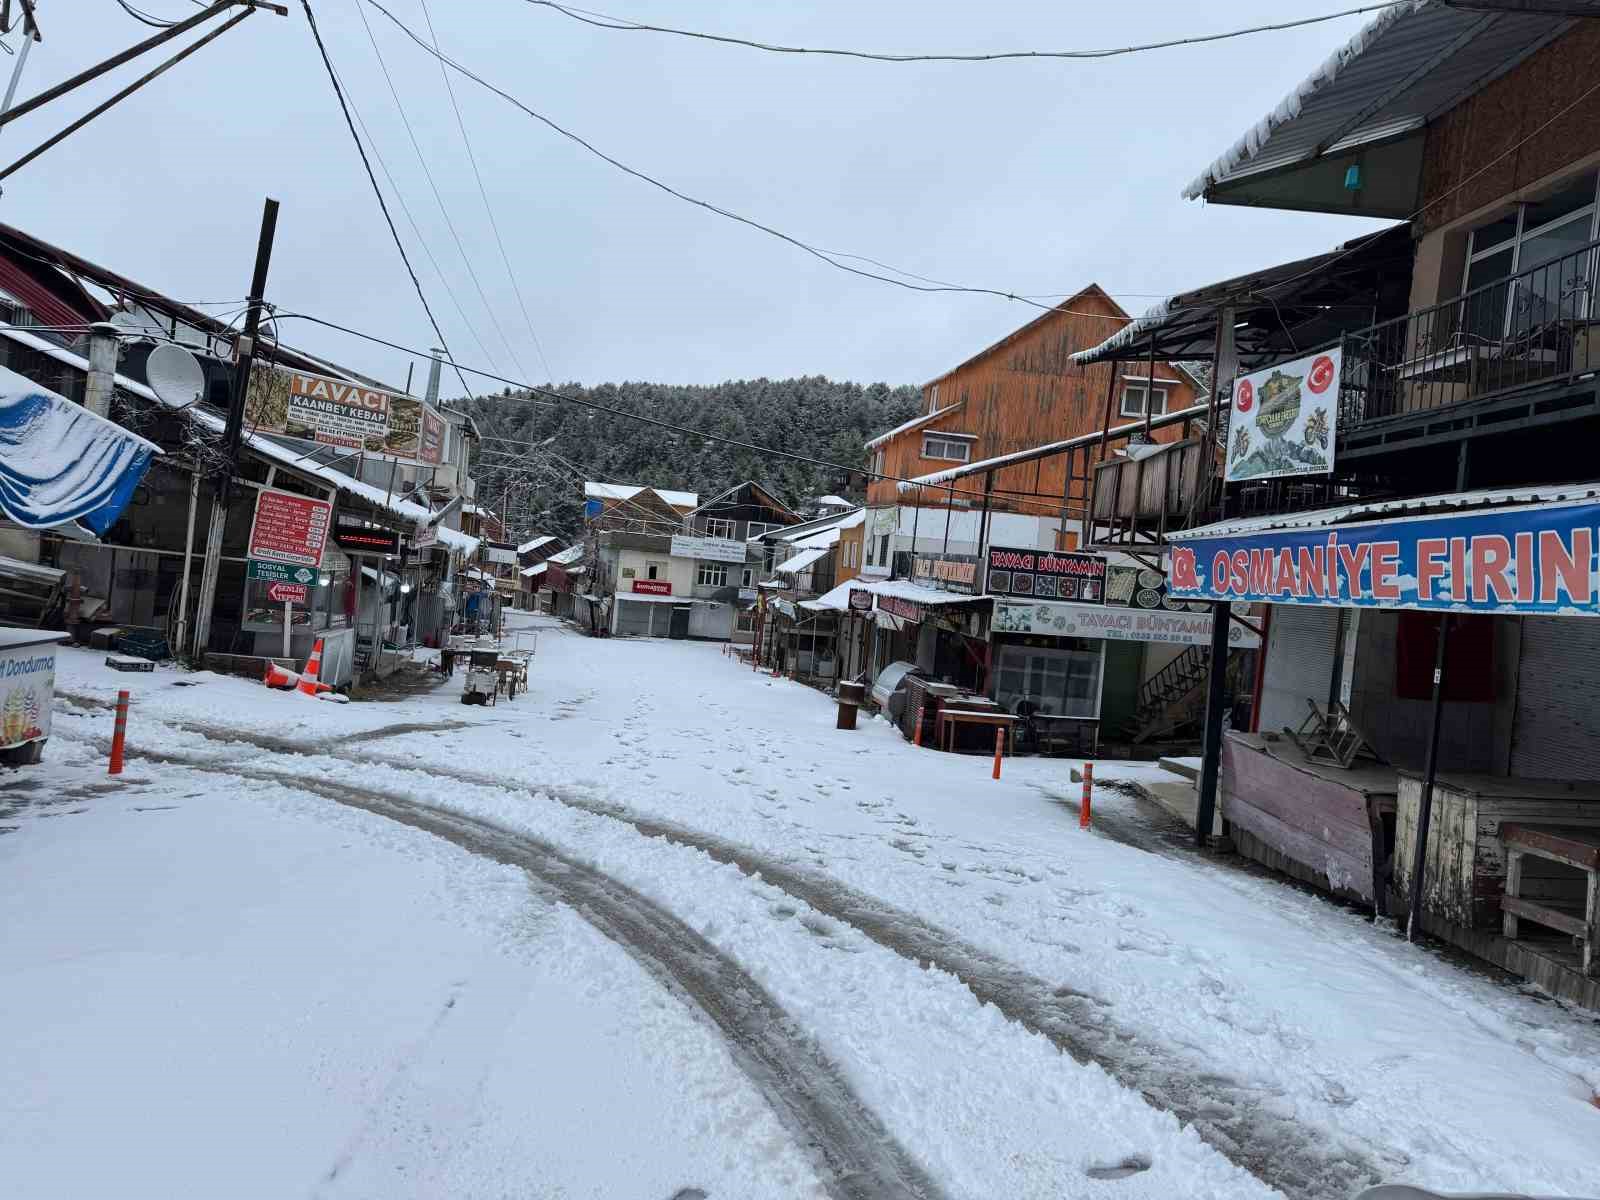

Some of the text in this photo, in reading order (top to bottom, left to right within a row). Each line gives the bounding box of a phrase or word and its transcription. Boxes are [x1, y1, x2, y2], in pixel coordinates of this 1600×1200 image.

[299, 375, 386, 409] TAVACI
[293, 396, 347, 414] KAANBEY
[349, 407, 386, 423] KEBAP
[257, 562, 287, 572] SOSYAL
[991, 551, 1105, 576] TAVACI BÜNYAMİN
[1212, 527, 1600, 603] OSMANİYE FIRIN
[1078, 612, 1132, 629] TAVACI
[6, 655, 54, 676] Dondurma
